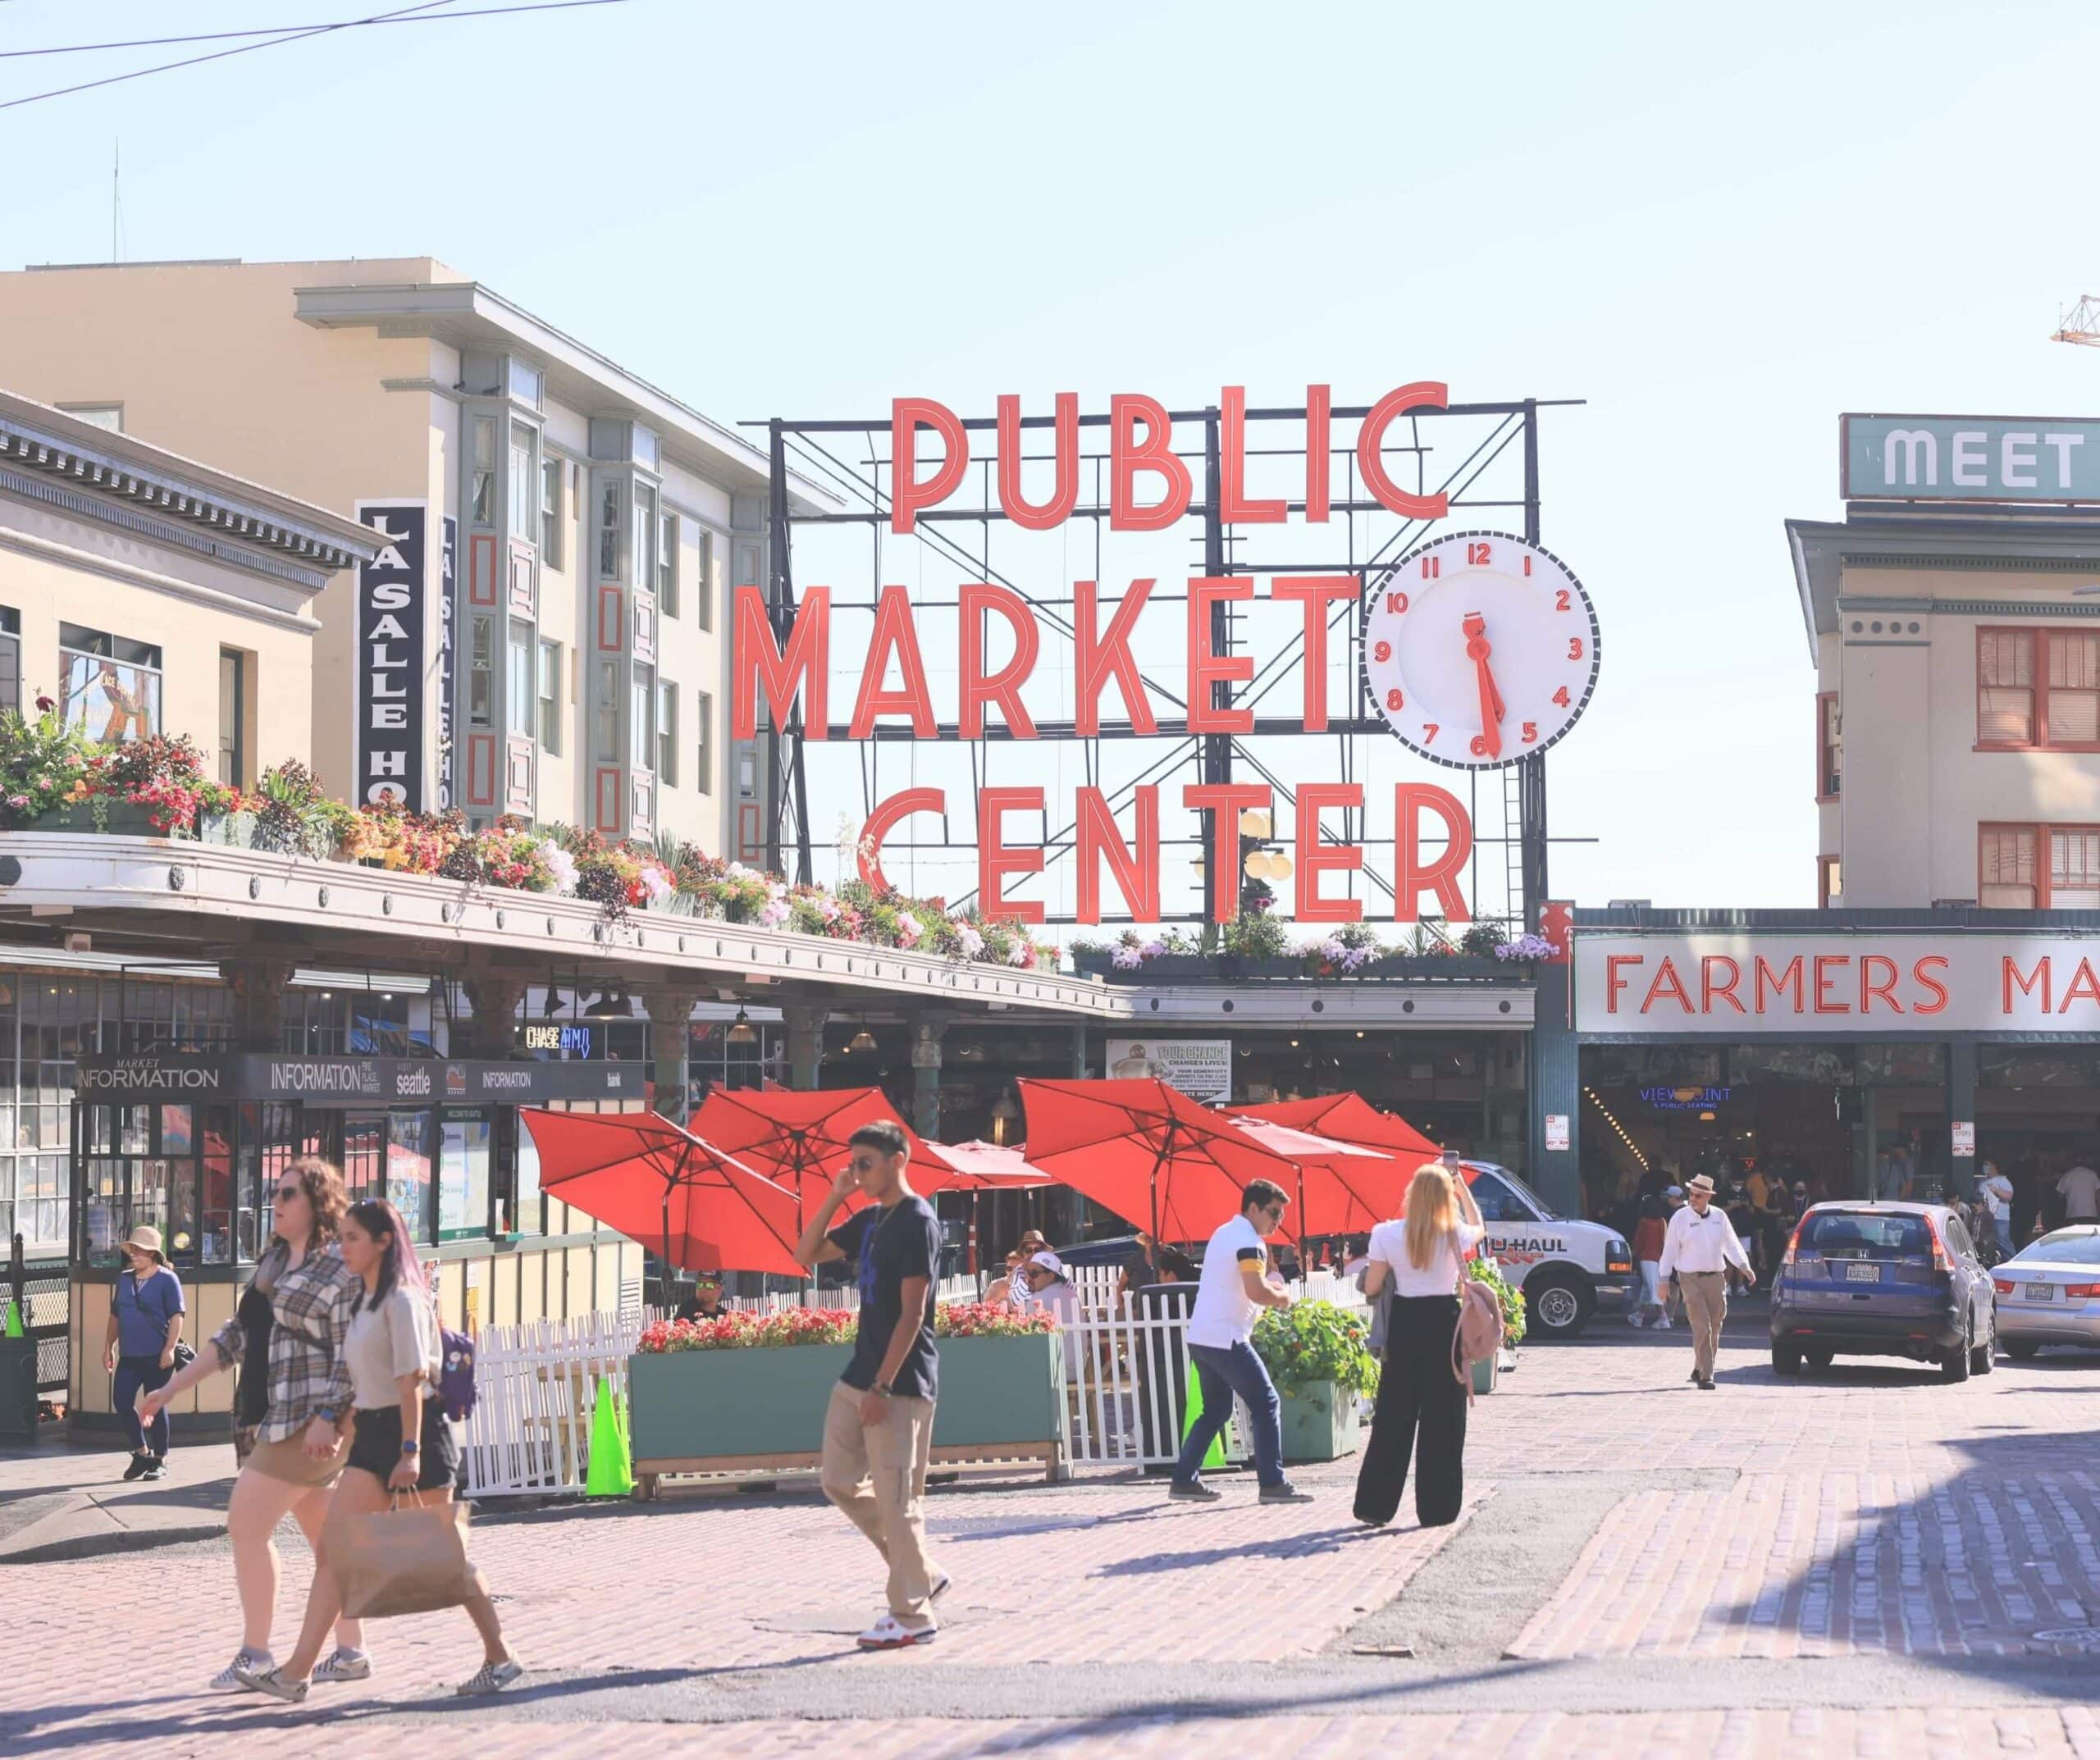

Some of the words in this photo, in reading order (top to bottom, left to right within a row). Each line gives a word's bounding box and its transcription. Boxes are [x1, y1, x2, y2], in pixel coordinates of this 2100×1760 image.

[891, 381, 1449, 535] PUBLIC
[1884, 429, 2084, 488] MEET
[368, 516, 411, 569] LA
[441, 523, 452, 578] LA
[1468, 543, 1491, 564] 12
[1422, 557, 1439, 579] 11
[1524, 555, 1531, 577] 1
[1387, 592, 1408, 613] 10
[1555, 590, 1570, 611] 2
[368, 583, 411, 728] SALLE
[732, 577, 1362, 741] MARKET
[1374, 641, 1391, 662] 9
[1568, 638, 1582, 660] 3
[439, 595, 451, 737] SALLE
[1386, 689, 1404, 711] 8
[1552, 686, 1570, 708] 4
[1422, 724, 1439, 745] 7
[1522, 722, 1538, 743] 5
[1470, 736, 1486, 756] 6
[857, 782, 1473, 924] CENTER
[1606, 955, 1949, 1014] FARMERS
[2002, 955, 2100, 1014] MA
[526, 1026, 559, 1049] CHASE
[560, 1027, 581, 1050] ATM
[116, 1058, 160, 1068] MARKET
[272, 1062, 362, 1090] INFORMATION
[396, 1065, 431, 1096] seattle
[482, 1071, 531, 1087] INFORMATION
[607, 1072, 621, 1087] bank
[1491, 1238, 1567, 1252] U-HAUL
